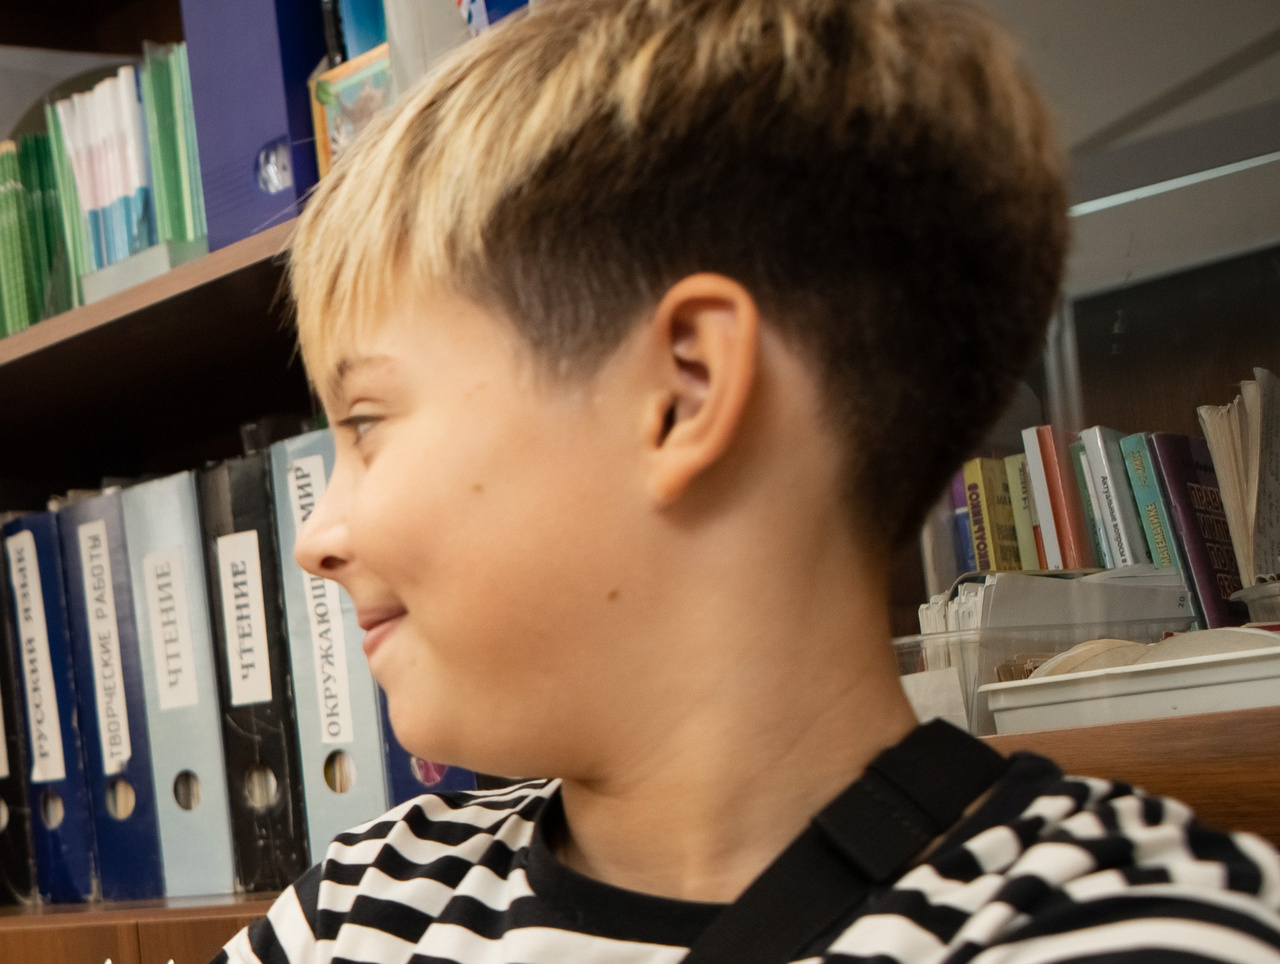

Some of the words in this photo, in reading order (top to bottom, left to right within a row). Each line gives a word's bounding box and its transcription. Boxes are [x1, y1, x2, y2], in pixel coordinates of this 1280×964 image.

[294, 466, 316, 523] МИР
[967, 482, 991, 571] ШКОЛЬНИКОВ
[1100, 475, 1117, 521] Актуальные
[1113, 521, 1126, 557] вопросы
[1146, 502, 1172, 567] МАТЕМАТИКЕ
[16, 546, 34, 621] ЯЗЫК
[88, 533, 108, 620] РАБОТЫ
[230, 560, 257, 681] ЧТЕНИЕ
[154, 561, 183, 688] ЧТЕНИЕ
[310, 576, 342, 738] ОКРУЖАЮЩ
[22, 636, 50, 758] РУССКИЙ
[99, 630, 123, 760] ТВОРЧЕСКИЕ
